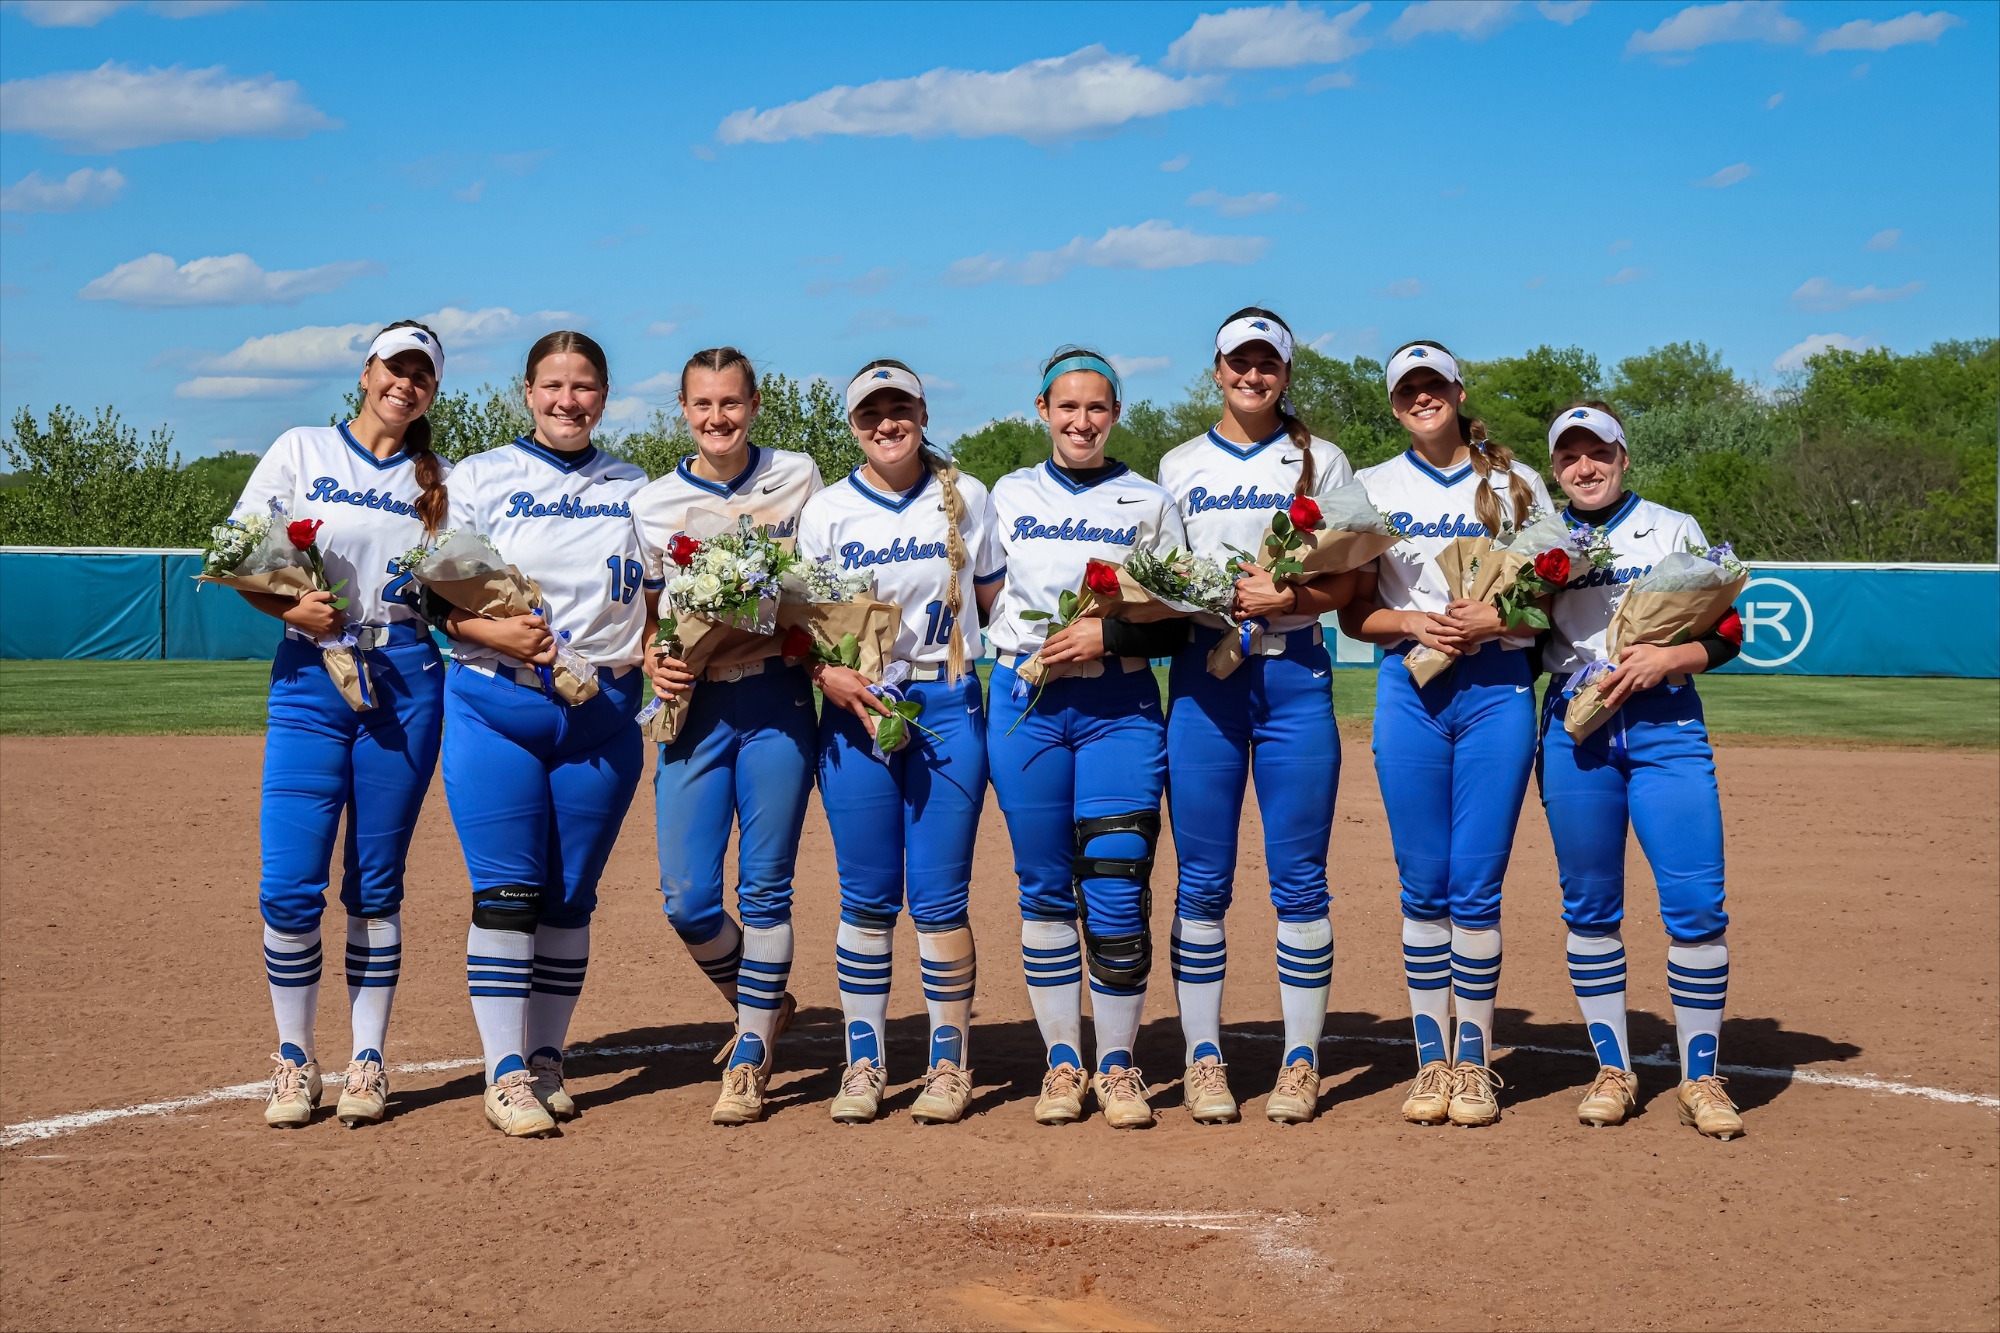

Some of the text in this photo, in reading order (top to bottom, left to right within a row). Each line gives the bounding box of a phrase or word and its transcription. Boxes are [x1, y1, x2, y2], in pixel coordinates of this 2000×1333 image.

[306, 476, 422, 520] Rockhur
[506, 491, 632, 518] Rockhurst
[1189, 485, 1296, 516] Rockhurs
[1011, 515, 1138, 546] Rockhurst
[840, 536, 948, 570] Rockhur
[381, 556, 421, 614] 2
[606, 554, 644, 605] 19
[924, 600, 956, 645] 16
